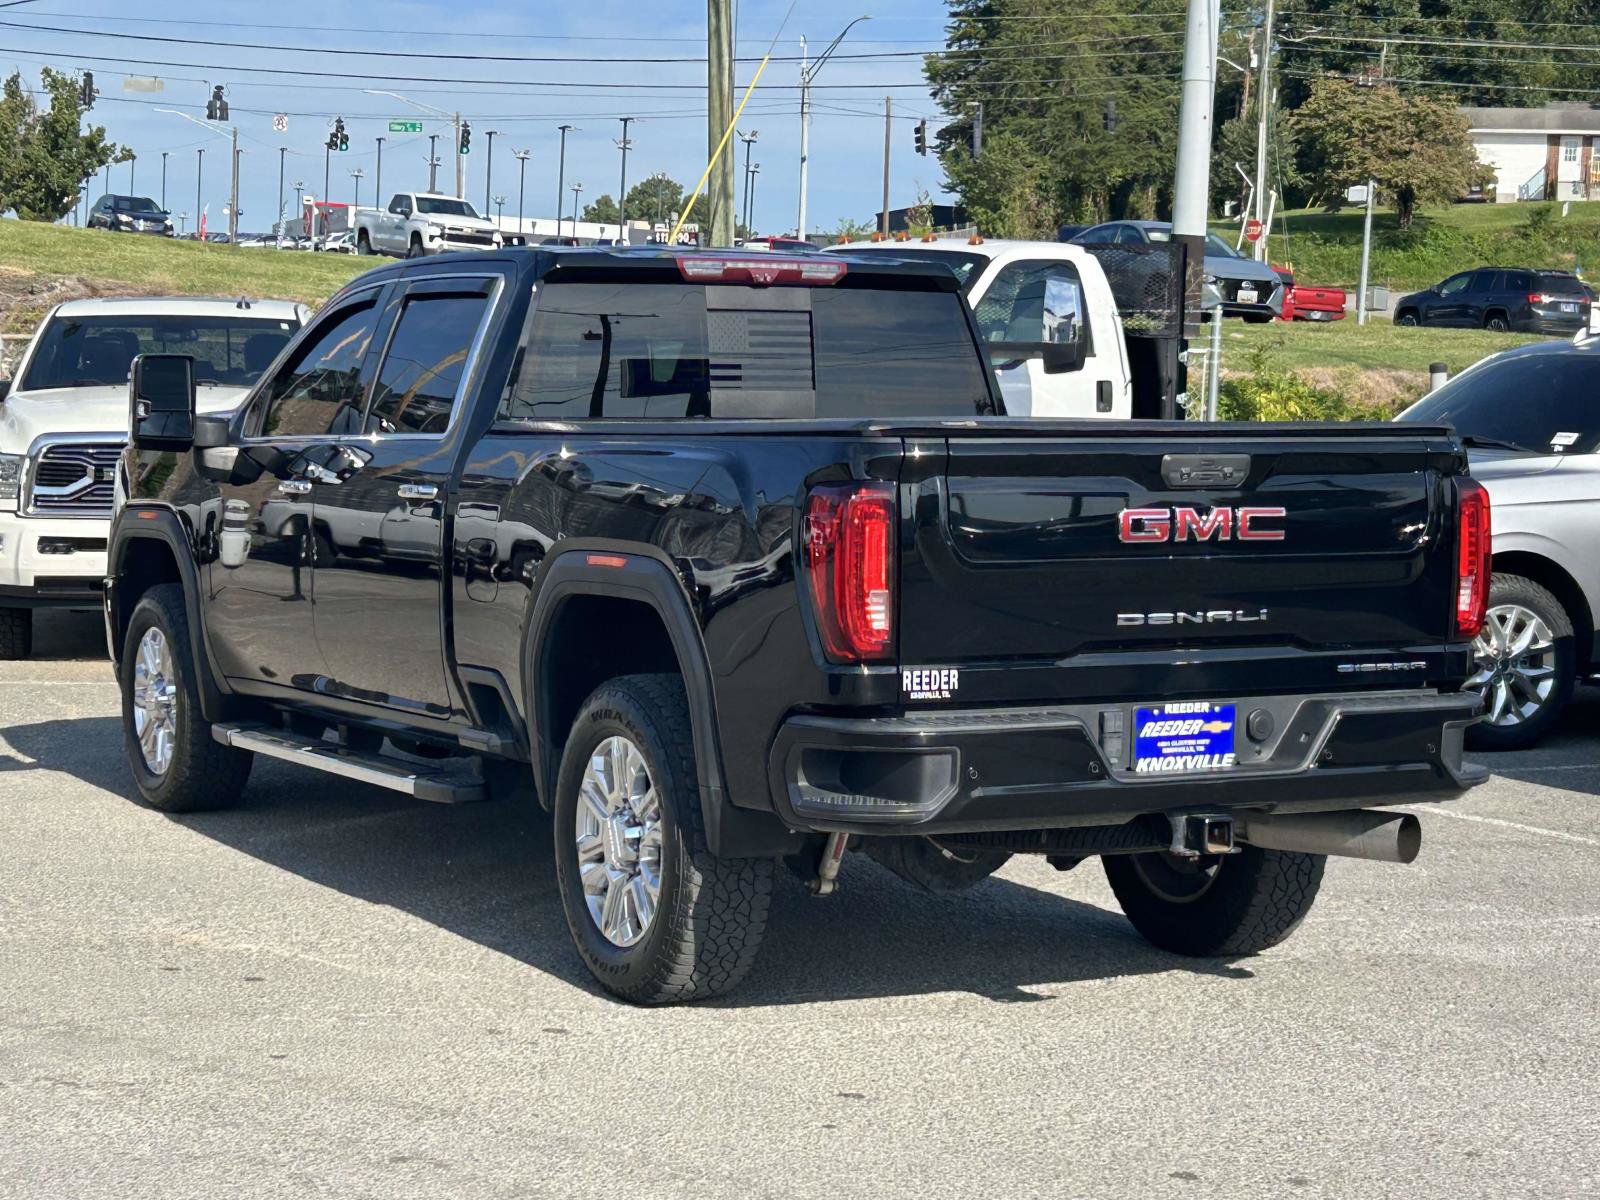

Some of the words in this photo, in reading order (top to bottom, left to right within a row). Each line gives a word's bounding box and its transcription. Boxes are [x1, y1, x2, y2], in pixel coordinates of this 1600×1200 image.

[1118, 505, 1287, 543] GMC
[1116, 608, 1269, 626] DENALI
[1337, 661, 1426, 673] SIERRA
[902, 669, 959, 691] REEDER
[1164, 702, 1210, 714] REEDER
[1139, 719, 1205, 737] REEDER
[1136, 753, 1236, 772] KNOXVILLE
